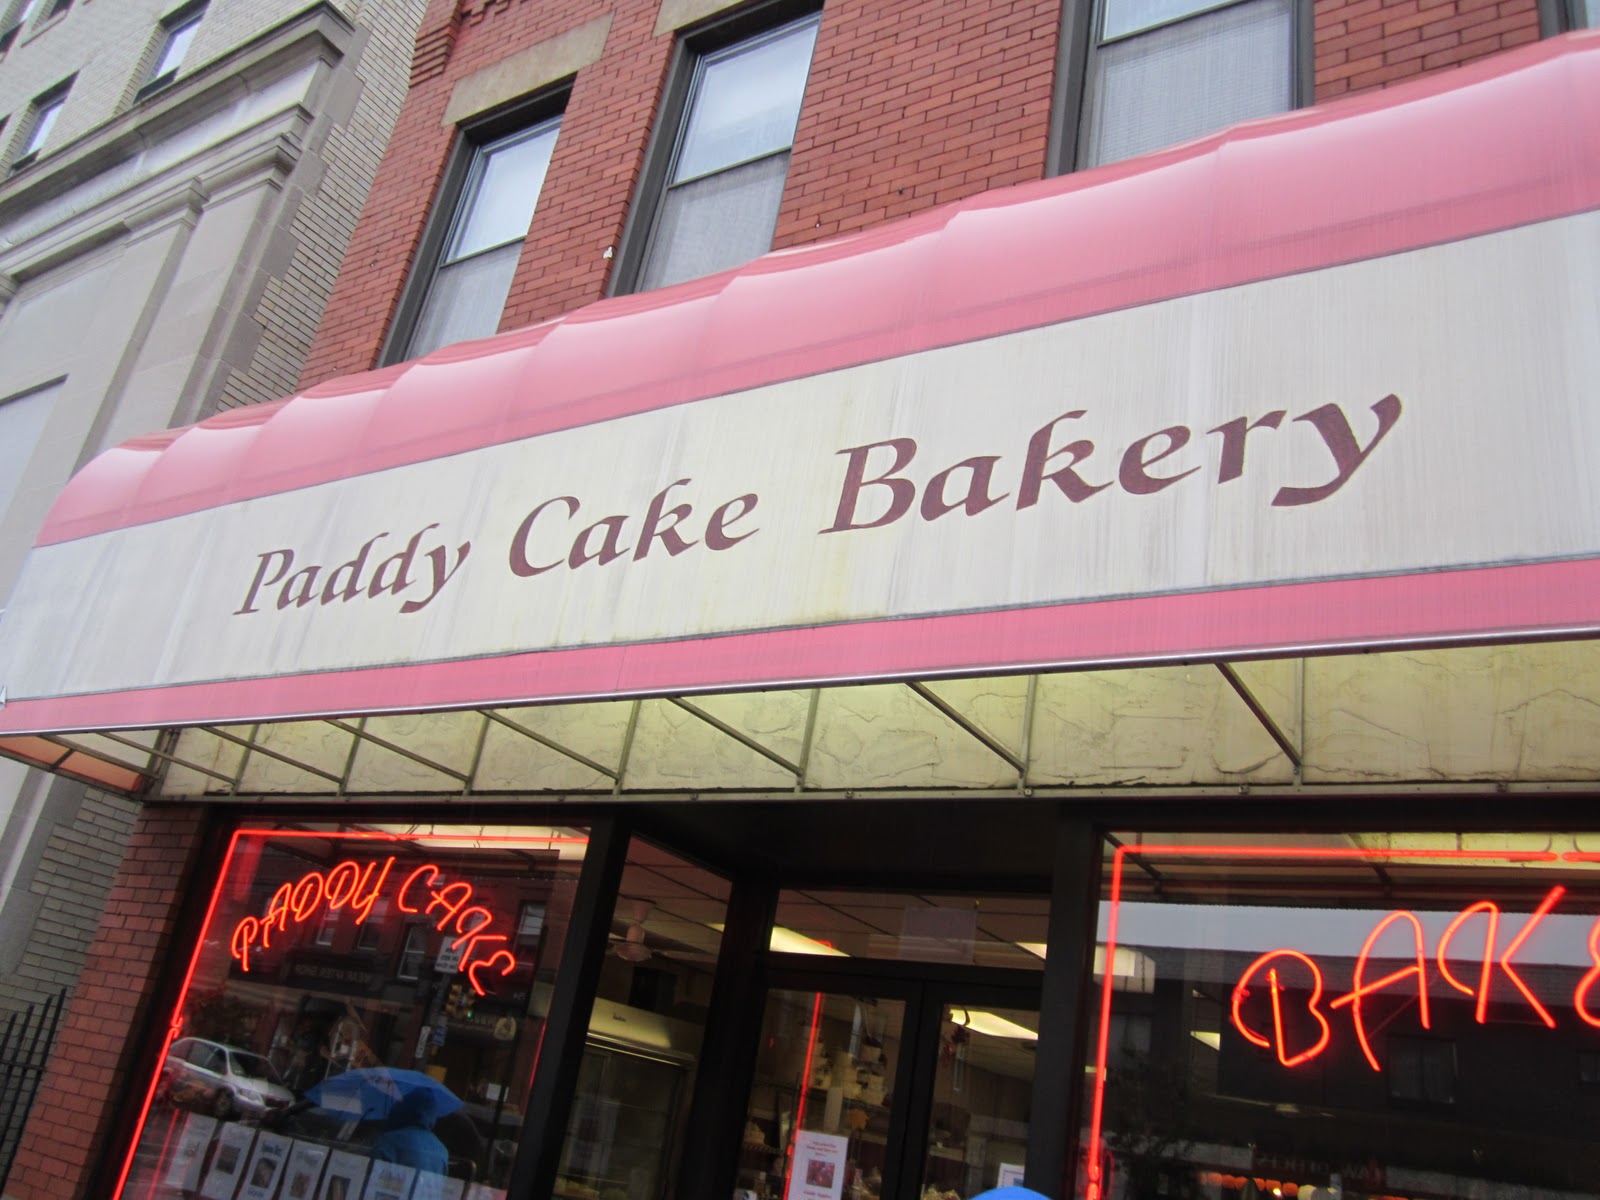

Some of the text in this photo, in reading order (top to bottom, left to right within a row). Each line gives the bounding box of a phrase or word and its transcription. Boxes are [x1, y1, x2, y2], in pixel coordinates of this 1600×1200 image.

[232, 393, 1404, 616] Paddy Cake Bakery
[230, 855, 517, 997] PADDY CAKE
